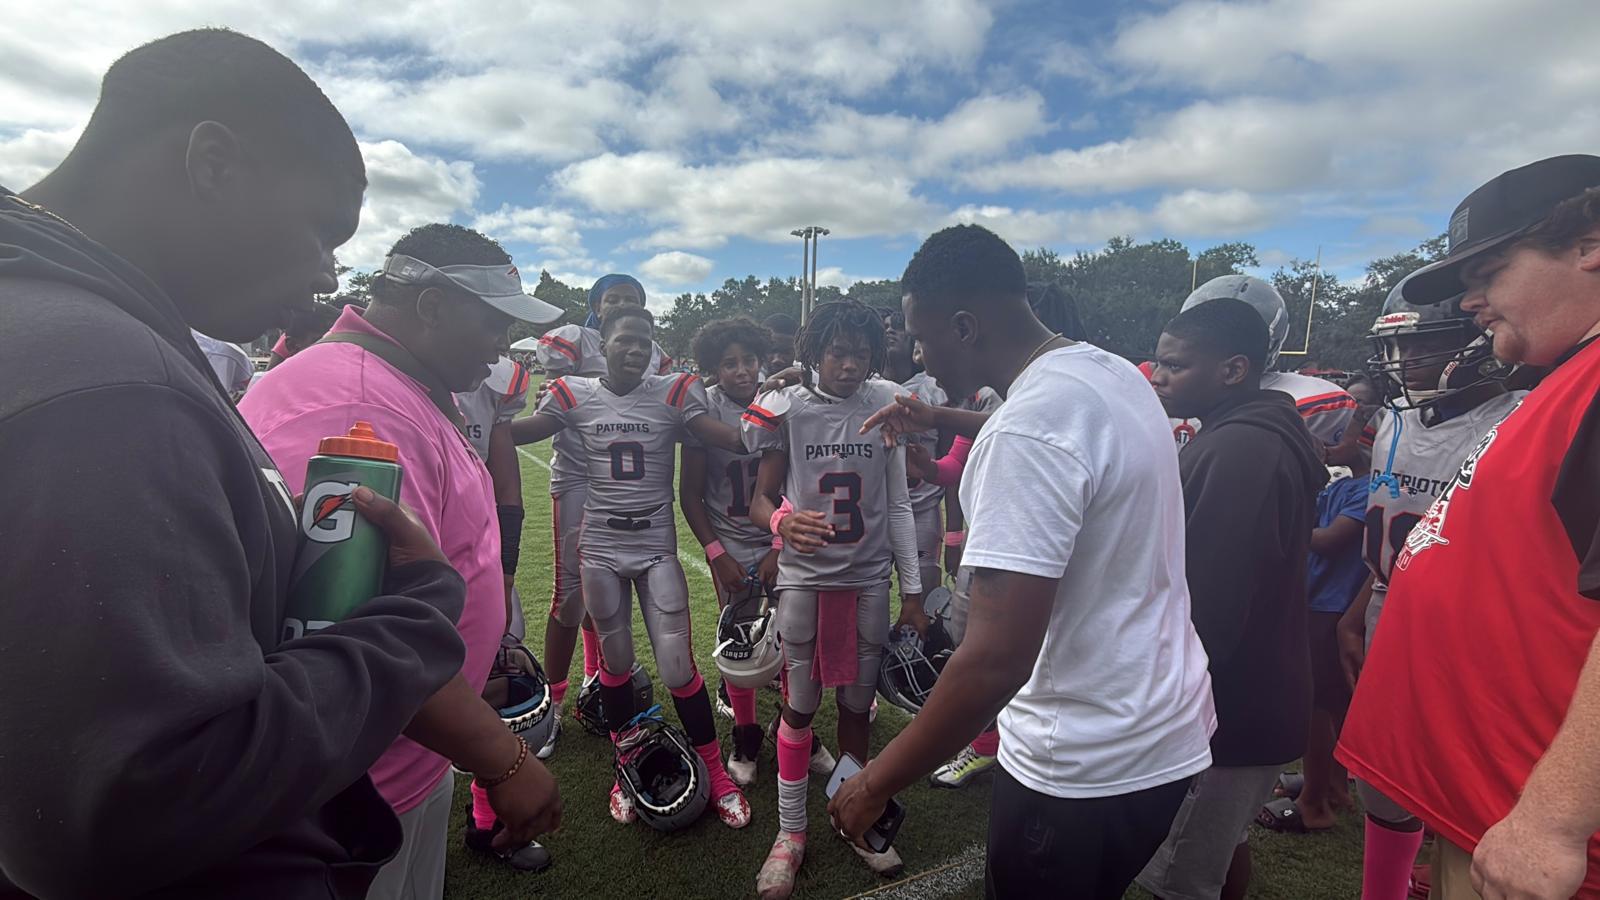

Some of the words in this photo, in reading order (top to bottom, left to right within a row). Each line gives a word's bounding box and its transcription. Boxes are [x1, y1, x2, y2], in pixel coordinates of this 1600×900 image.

[465, 424, 482, 438] TS
[596, 423, 650, 434] PATRIOTS
[608, 441, 645, 481] 0
[805, 443, 873, 460] PATRIOTS
[1372, 469, 1449, 498] PTRIOT
[818, 471, 865, 544] 3
